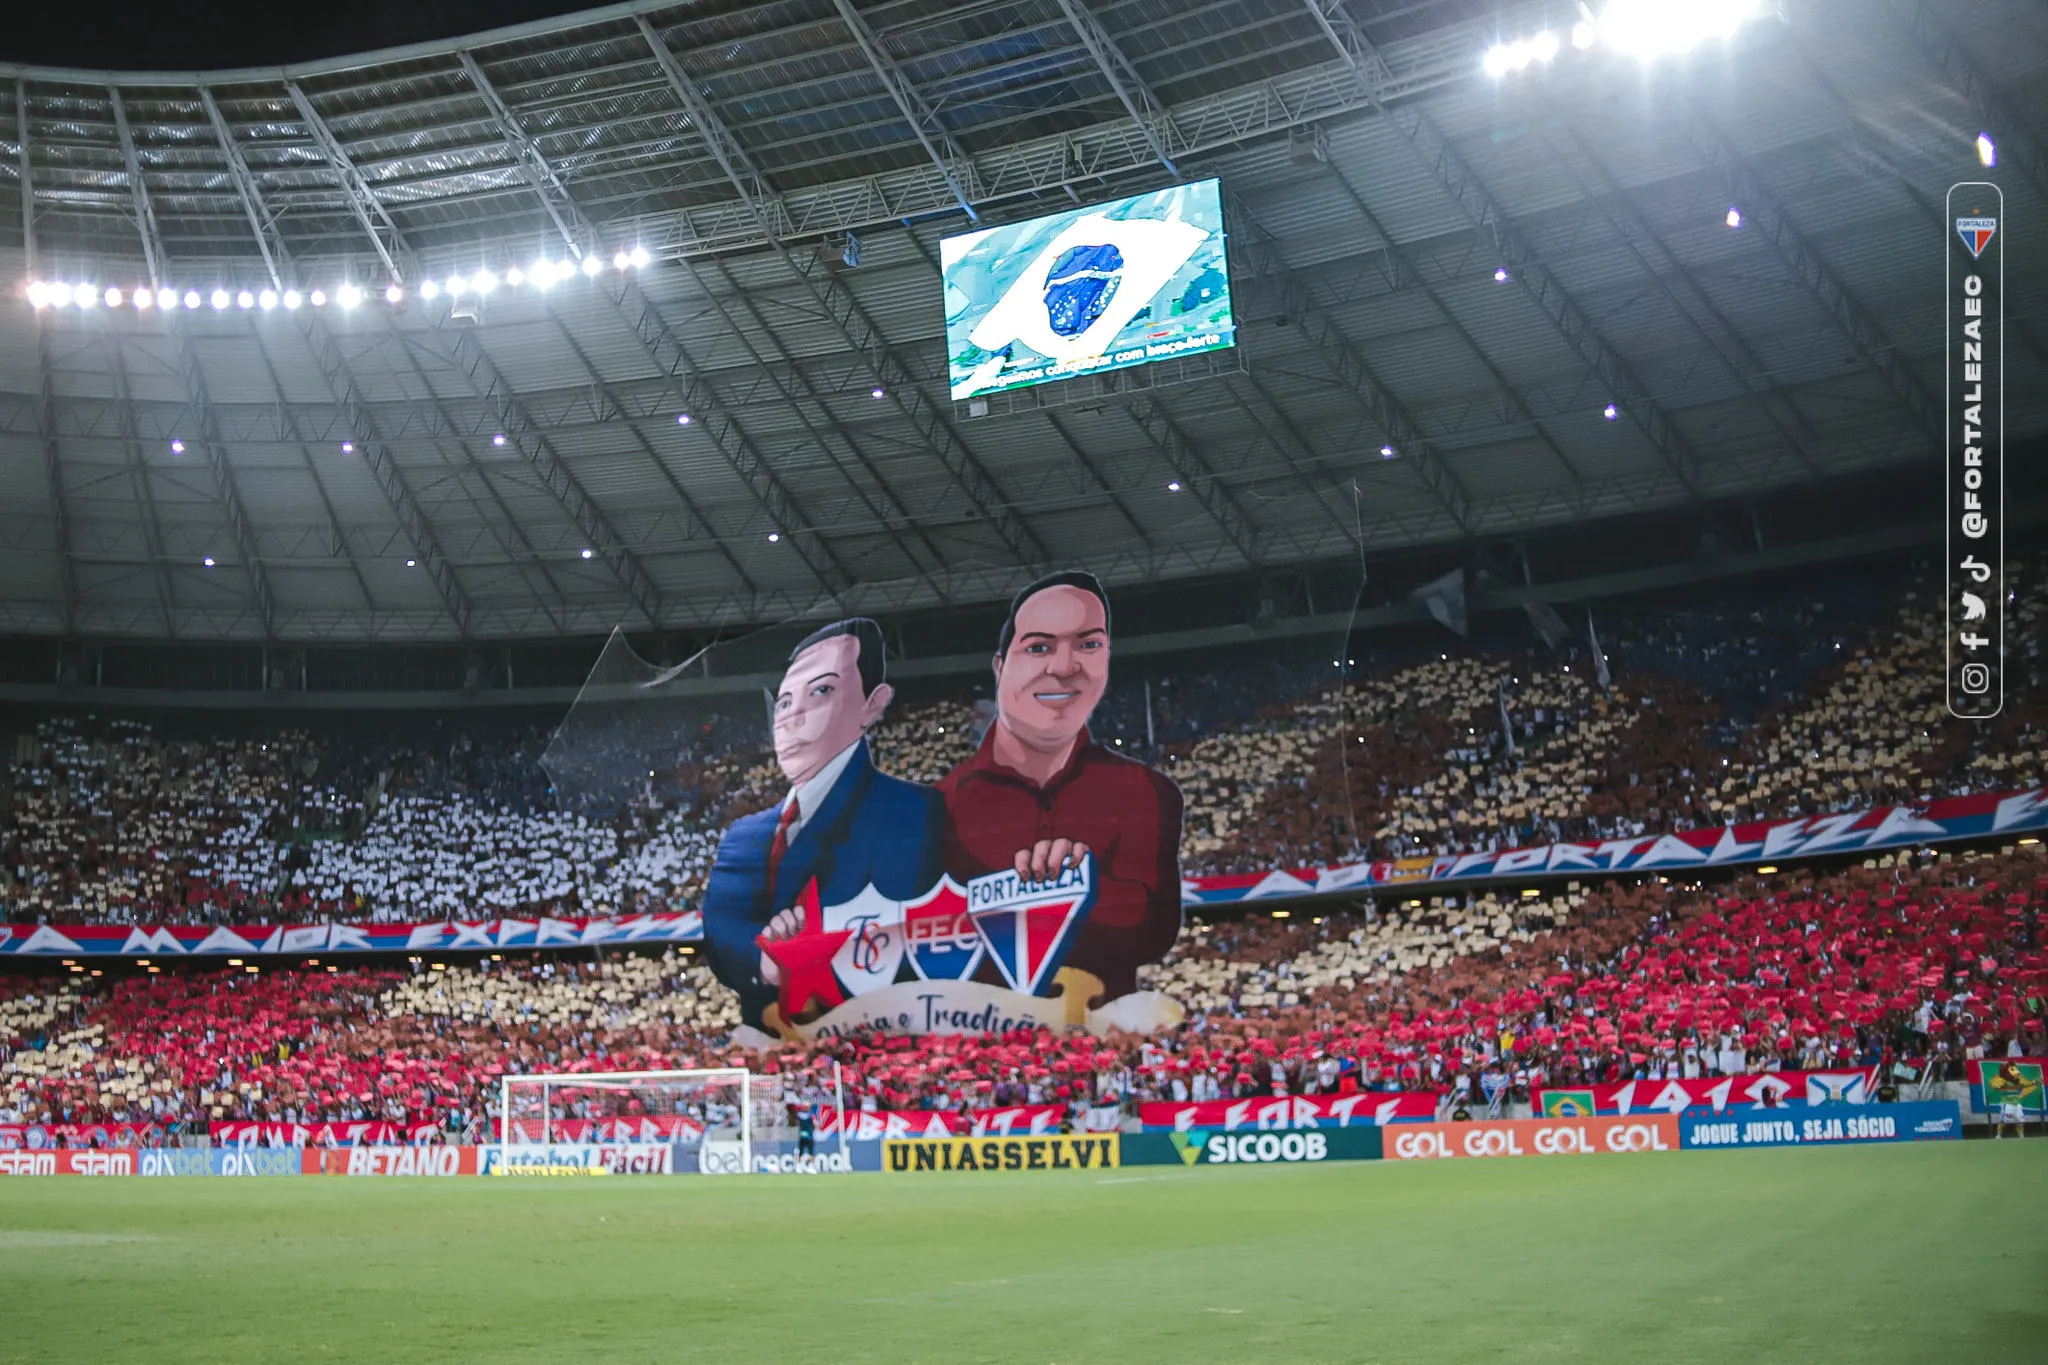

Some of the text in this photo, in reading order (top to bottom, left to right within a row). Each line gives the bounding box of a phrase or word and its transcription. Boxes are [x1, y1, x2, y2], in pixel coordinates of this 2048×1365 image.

[1115, 348, 1144, 363] com
[1446, 805, 1948, 877] FORTALEZA
[15, 925, 84, 953] A
[911, 912, 983, 955] FEC
[1464, 1128, 1523, 1156] GOL
[1534, 1126, 1595, 1155] GOL
[1606, 1123, 1668, 1152] GOL
[1690, 1123, 1739, 1145] JOGUE
[1742, 1120, 1800, 1143] JUNTO,
[1802, 1118, 1844, 1140] SEJA
[1847, 1114, 1896, 1138] SÓCIO
[889, 1138, 1112, 1171] UNIASSELVI
[1207, 1132, 1328, 1163] SICOOB
[1395, 1131, 1454, 1158] GOL
[348, 1147, 460, 1176] BETANO
